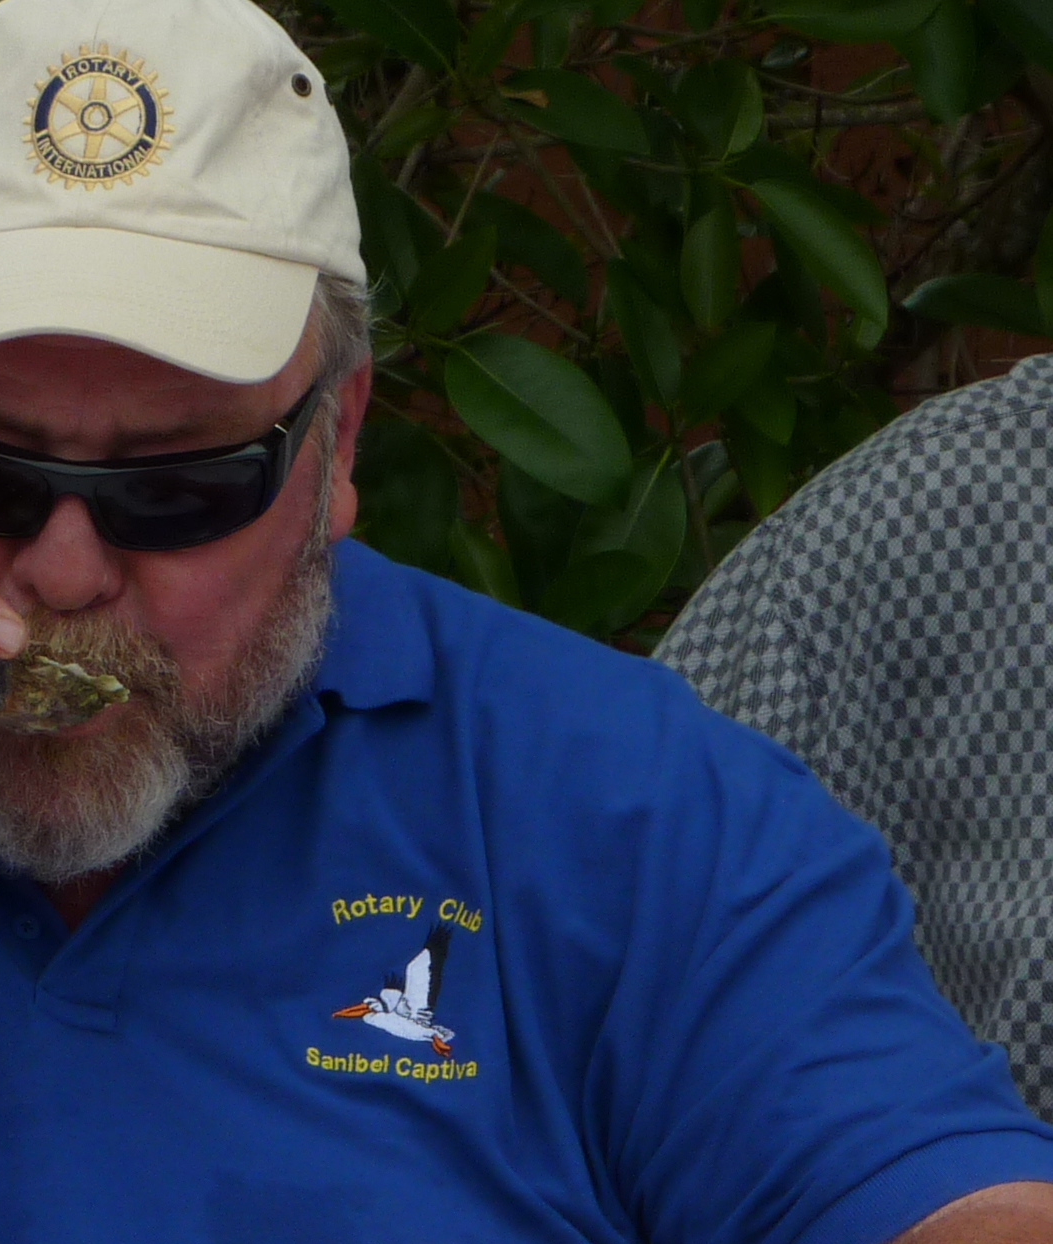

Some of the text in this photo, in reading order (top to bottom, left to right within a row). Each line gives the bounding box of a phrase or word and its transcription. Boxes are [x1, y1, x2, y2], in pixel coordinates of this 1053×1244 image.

[65, 58, 138, 82] ROTARY
[37, 137, 148, 178] INTERNATIONAL
[332, 893, 483, 933] Rotary Club
[305, 1046, 478, 1084] Sanibel Captiva
